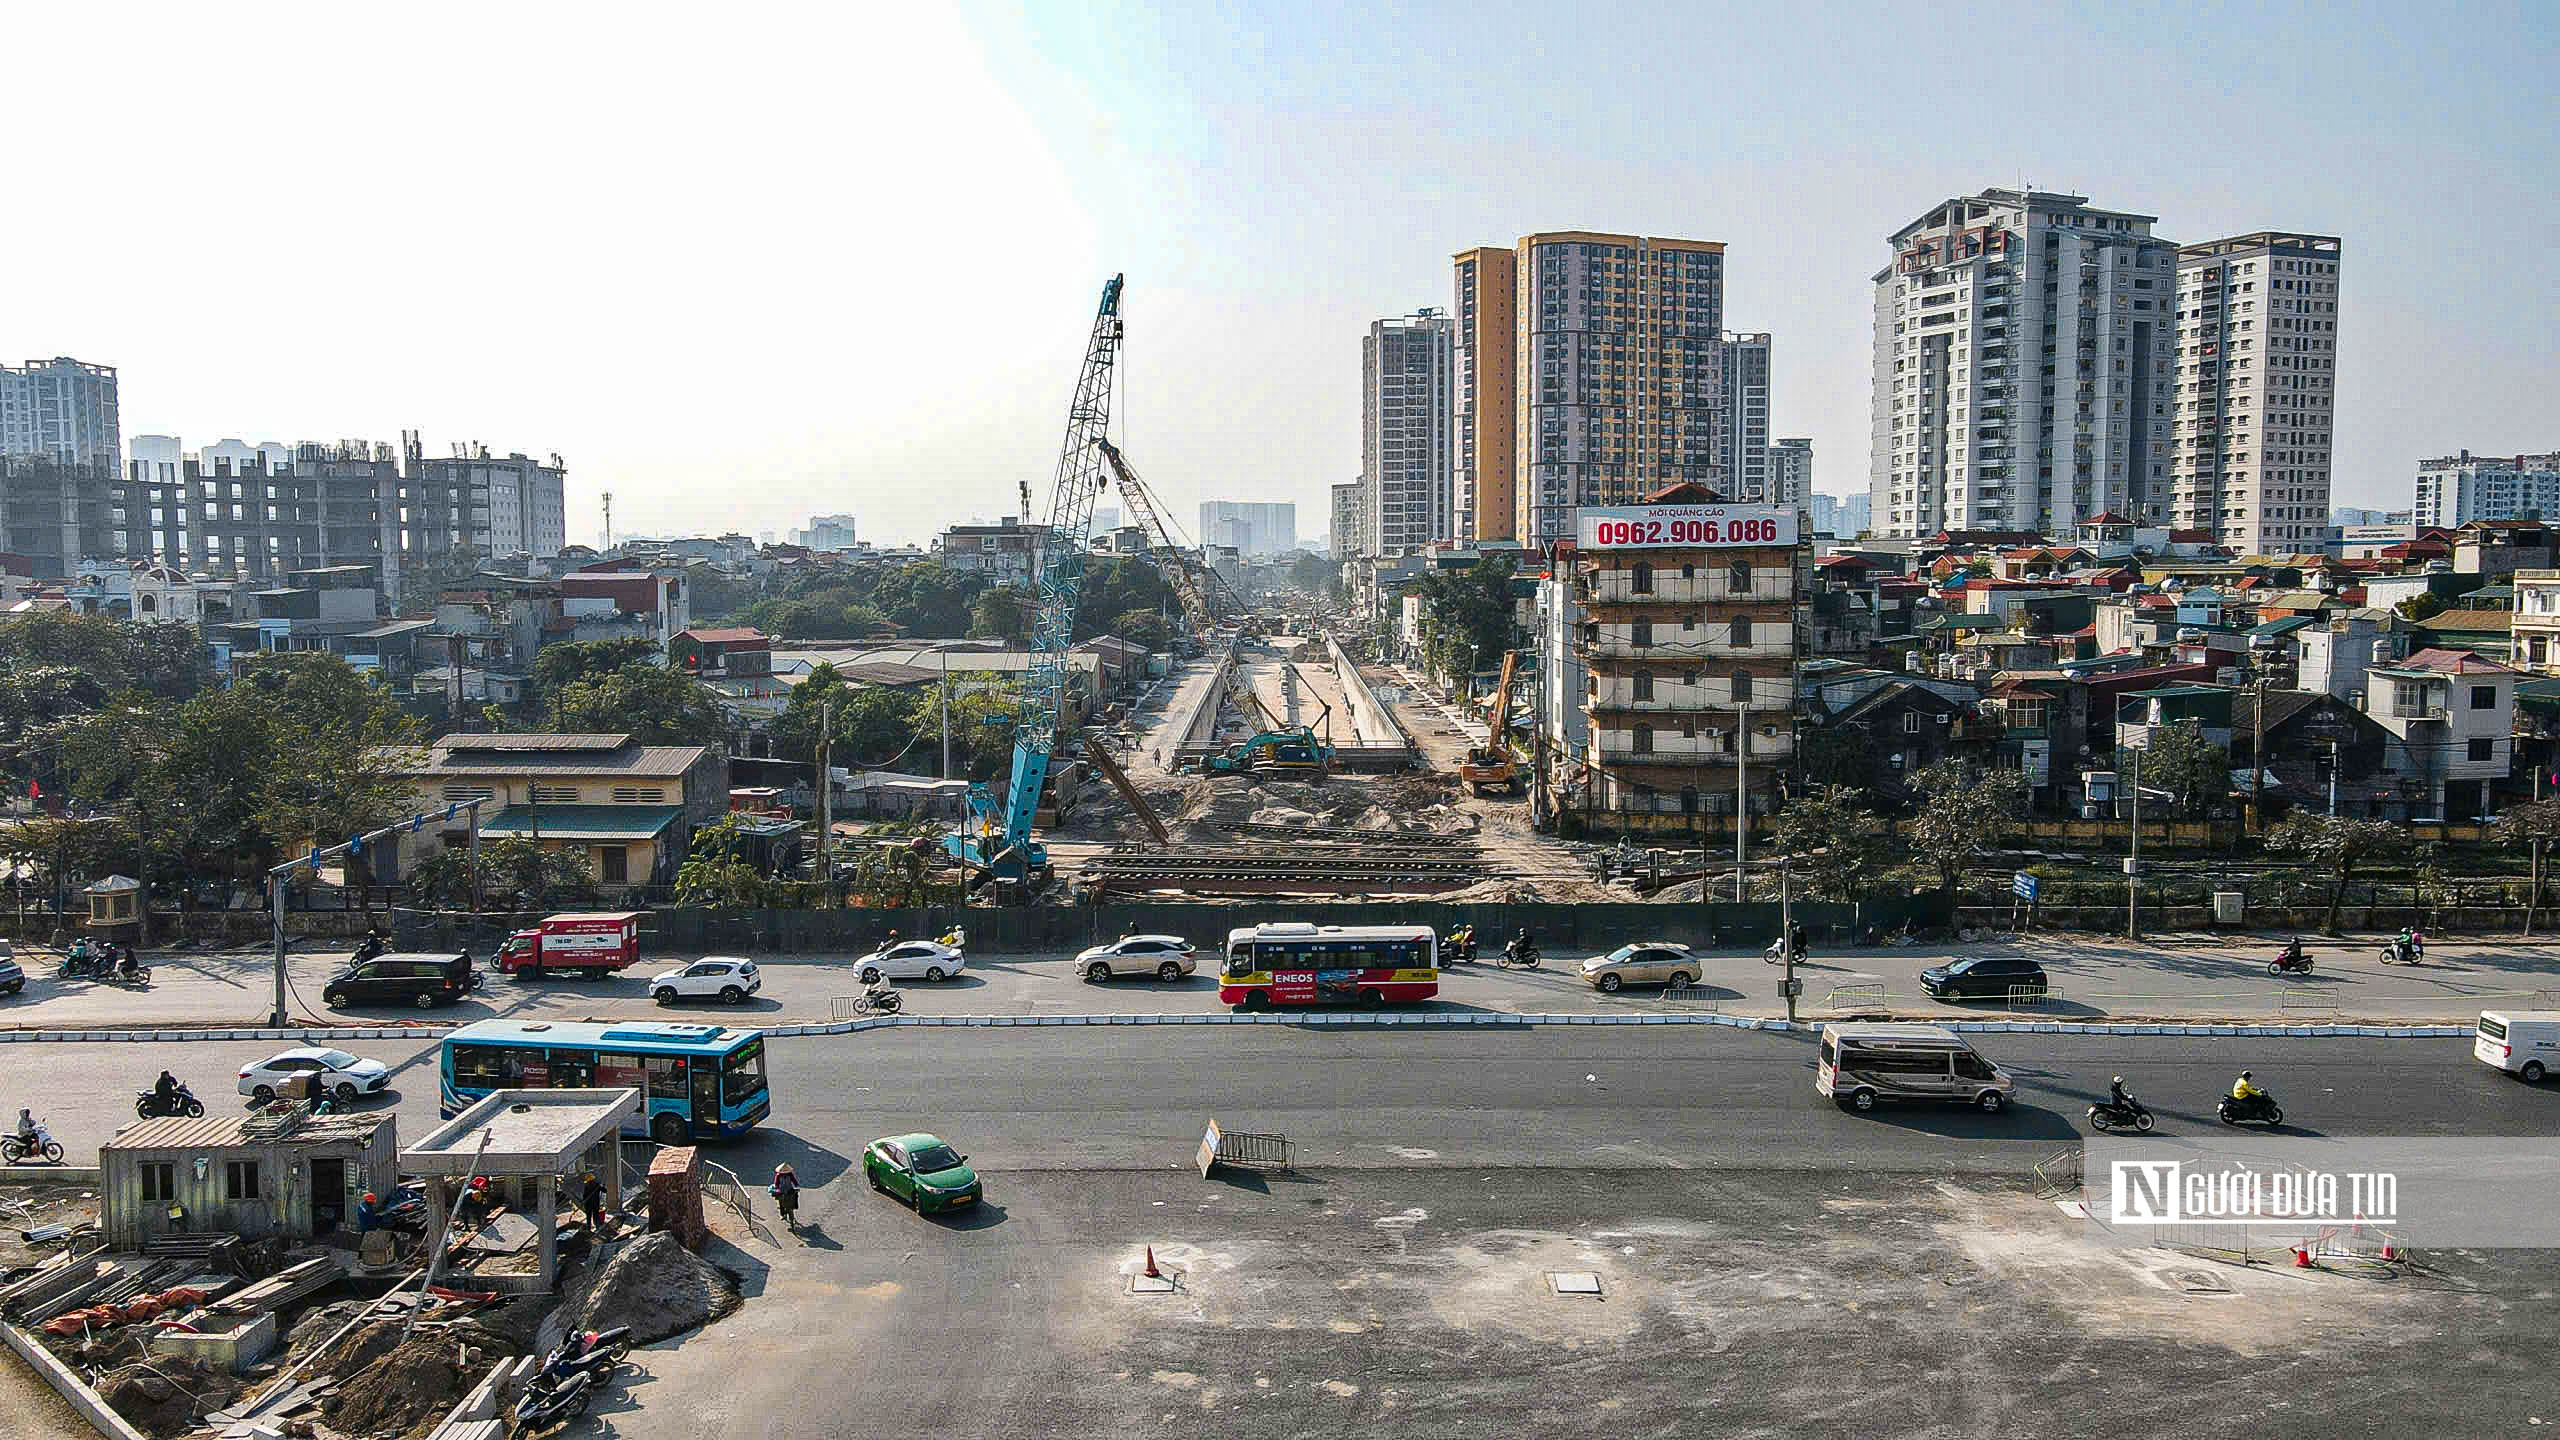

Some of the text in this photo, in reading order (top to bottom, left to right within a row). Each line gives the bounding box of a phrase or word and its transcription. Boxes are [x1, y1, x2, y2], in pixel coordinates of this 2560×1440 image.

[1704, 507, 1725, 517] CÁO
[1598, 518, 1777, 545] 0962.906.086
[1275, 973, 1313, 983] ENEOS
